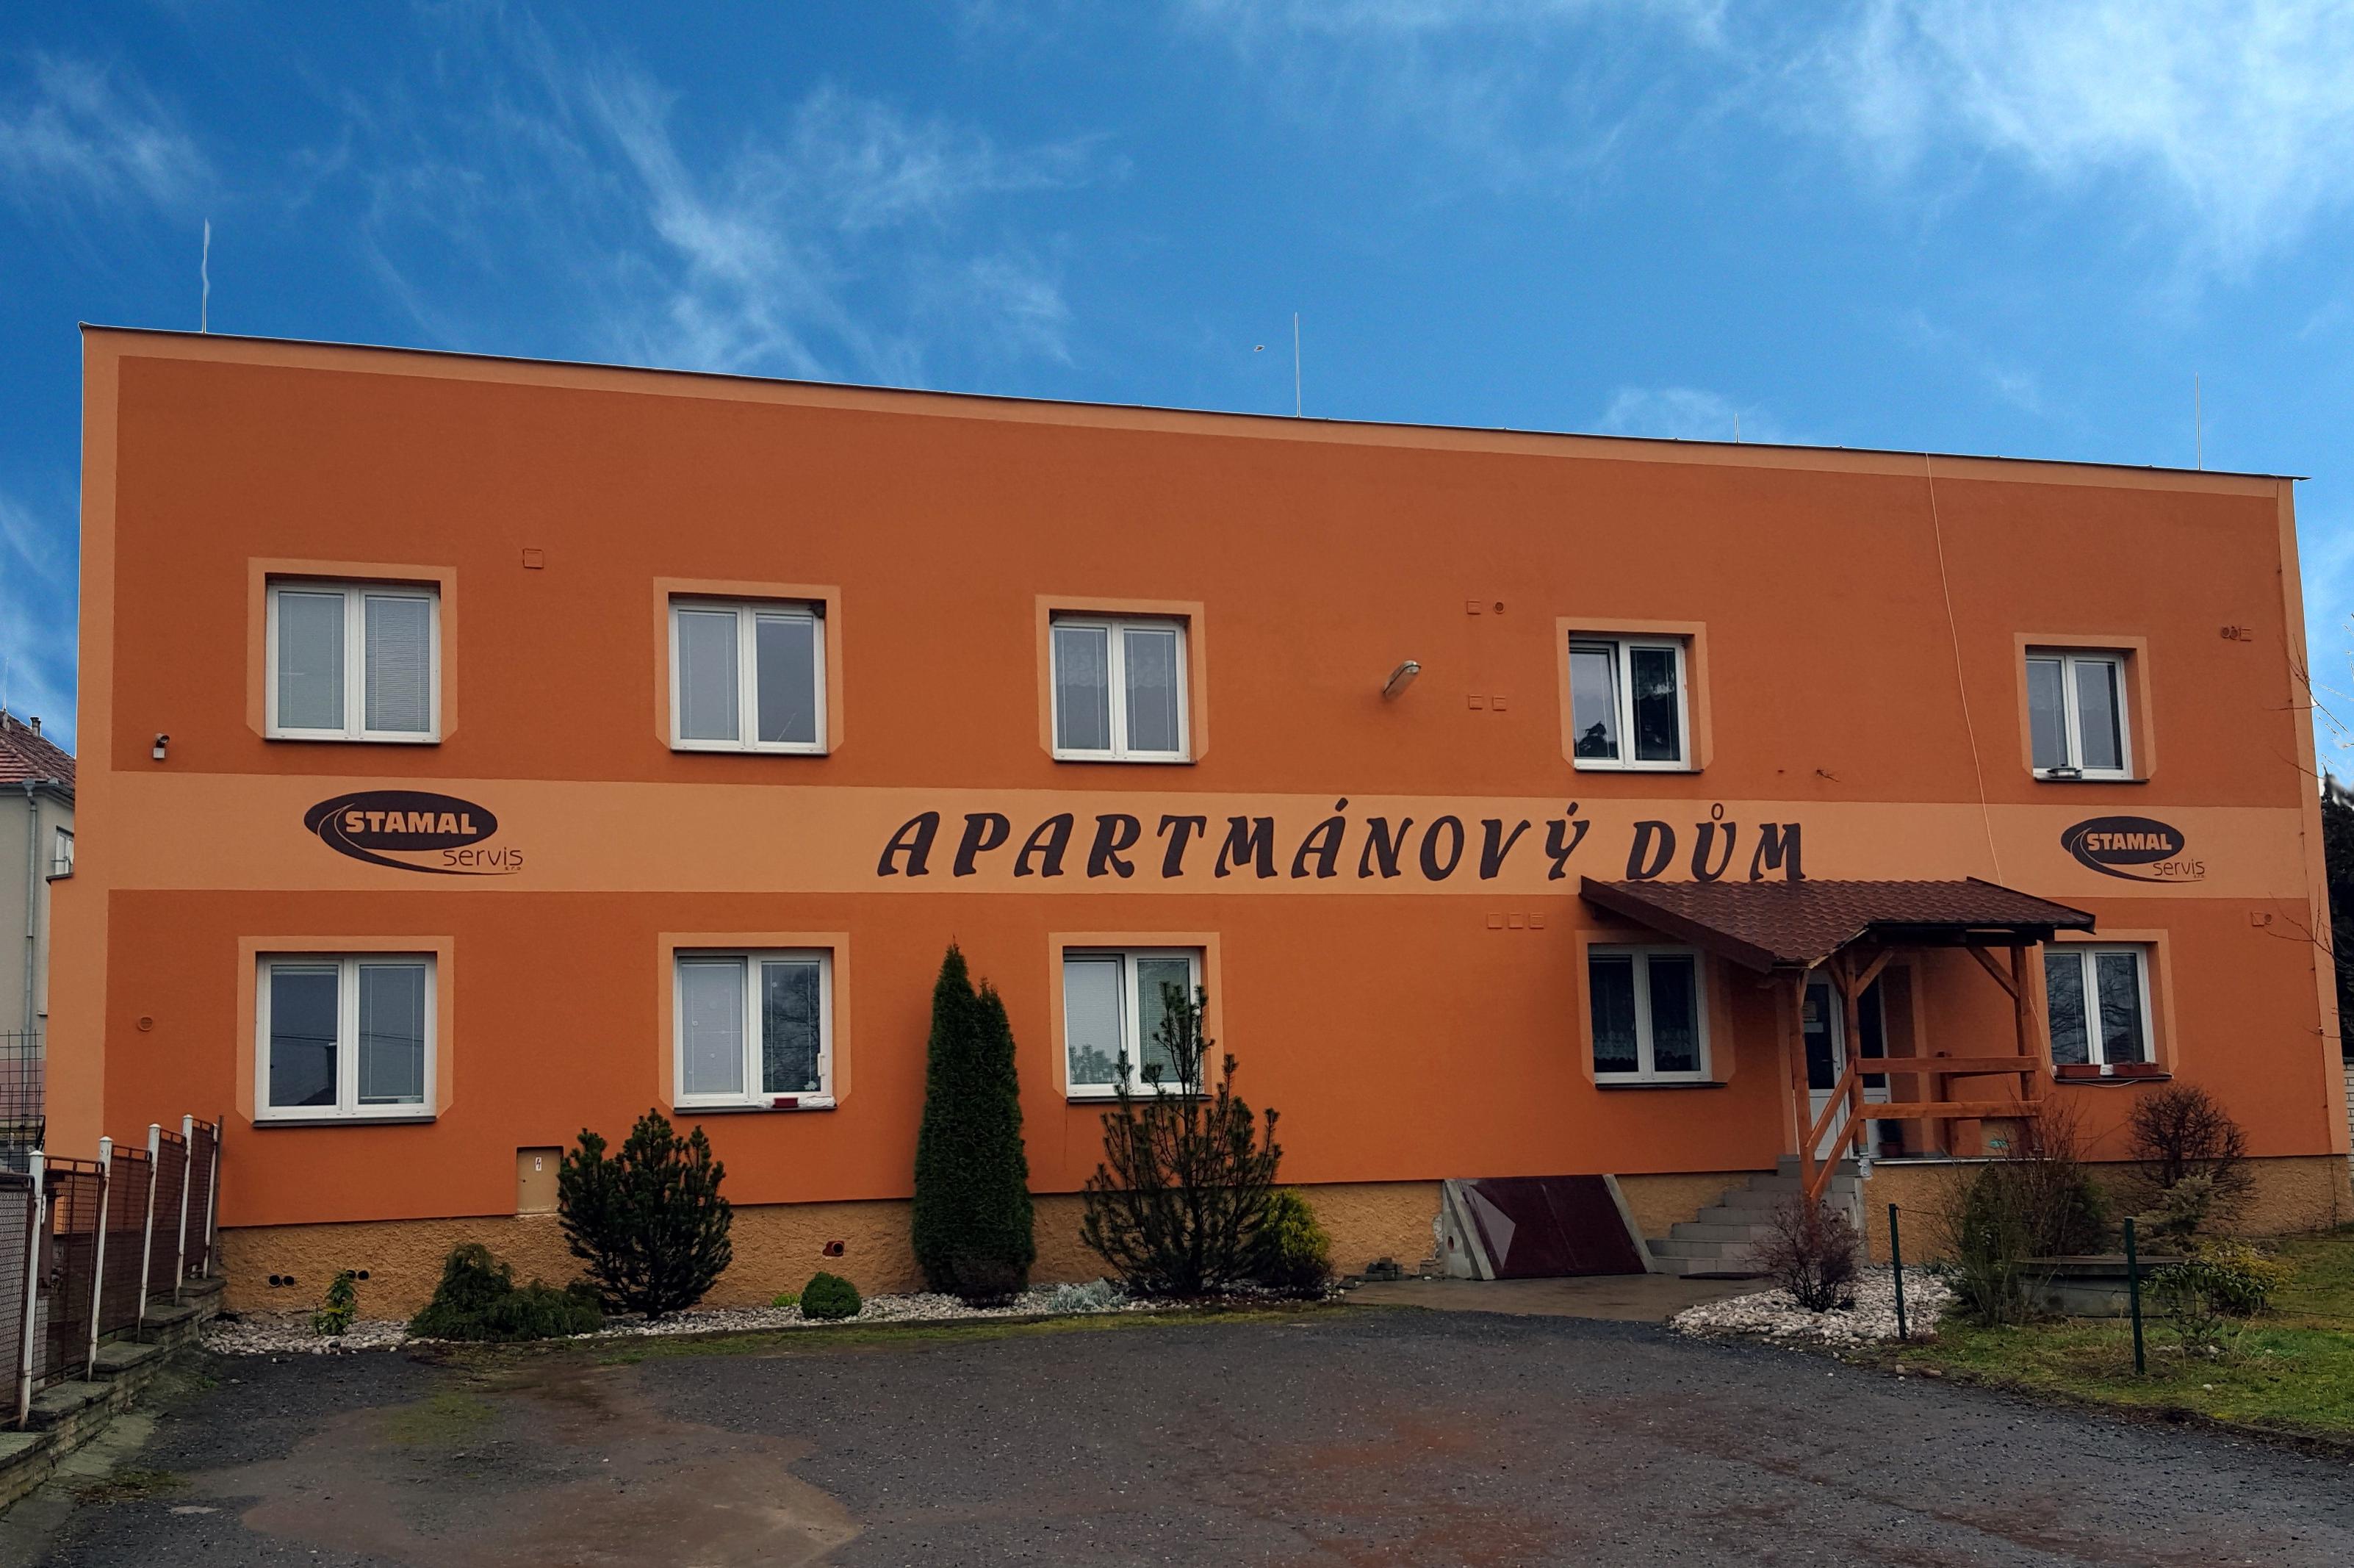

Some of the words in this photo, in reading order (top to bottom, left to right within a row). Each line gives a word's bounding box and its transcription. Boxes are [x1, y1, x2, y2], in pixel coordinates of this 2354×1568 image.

[345, 810, 478, 834] STAMAL
[877, 797, 1590, 881] APARTMÁNOVÝ
[1626, 803, 1806, 882] DŮM
[2087, 832, 2172, 851] STAMAL
[442, 846, 523, 866] servis
[2152, 858, 2205, 876] servis
